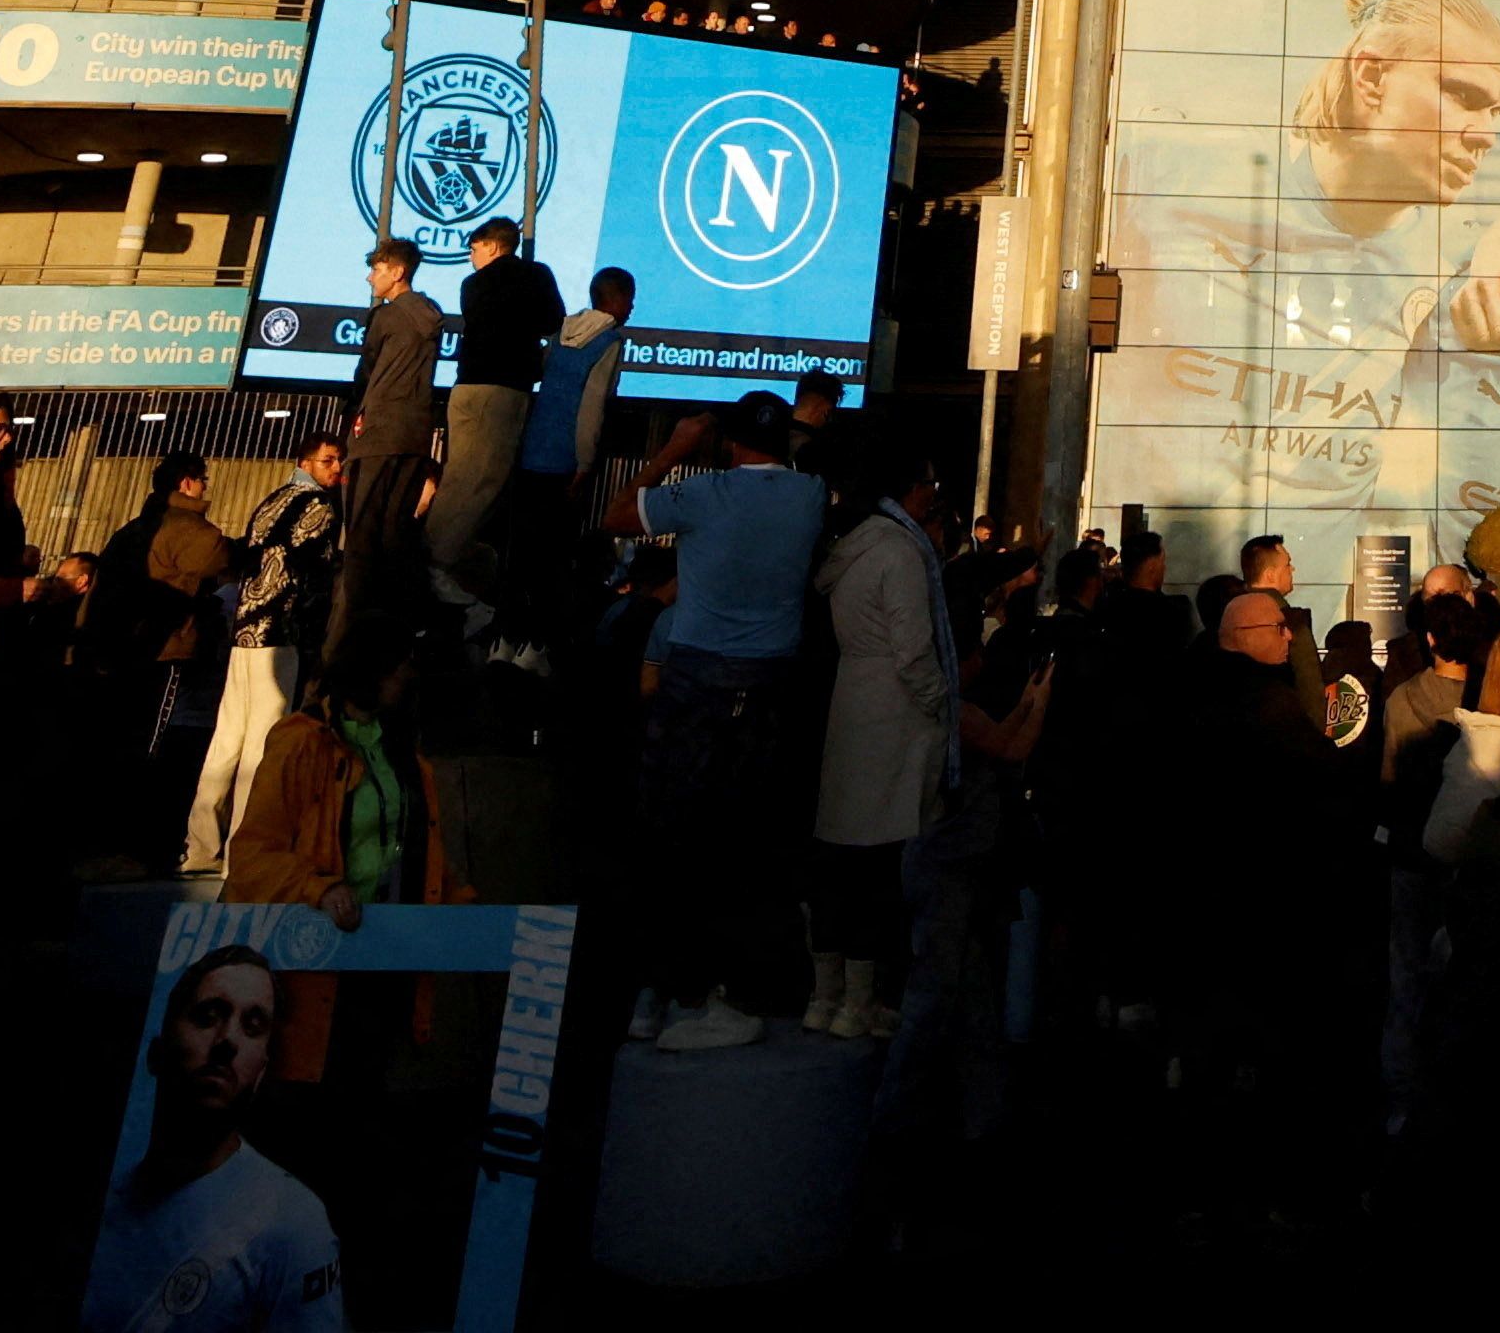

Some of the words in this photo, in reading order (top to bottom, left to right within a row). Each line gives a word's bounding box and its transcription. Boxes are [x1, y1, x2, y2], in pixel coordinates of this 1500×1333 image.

[91, 30, 143, 57] City
[145, 34, 200, 57] win
[202, 37, 263, 61] their
[85, 60, 213, 89] European
[216, 65, 268, 91] Cup
[708, 143, 793, 234] N
[414, 225, 471, 247] CITY
[996, 211, 1012, 258] WEST
[27, 310, 57, 333] in
[57, 311, 103, 333] the
[107, 310, 143, 333] FA
[148, 311, 201, 338] Cup
[987, 262, 1008, 356] RECEPTION
[45, 342, 104, 365] side
[108, 345, 139, 364] to
[141, 342, 193, 364] win
[197, 347, 215, 363] a
[655, 342, 714, 368] team
[716, 346, 760, 370] and
[761, 349, 821, 374] make
[1220, 419, 1374, 468] AIRWAYS
